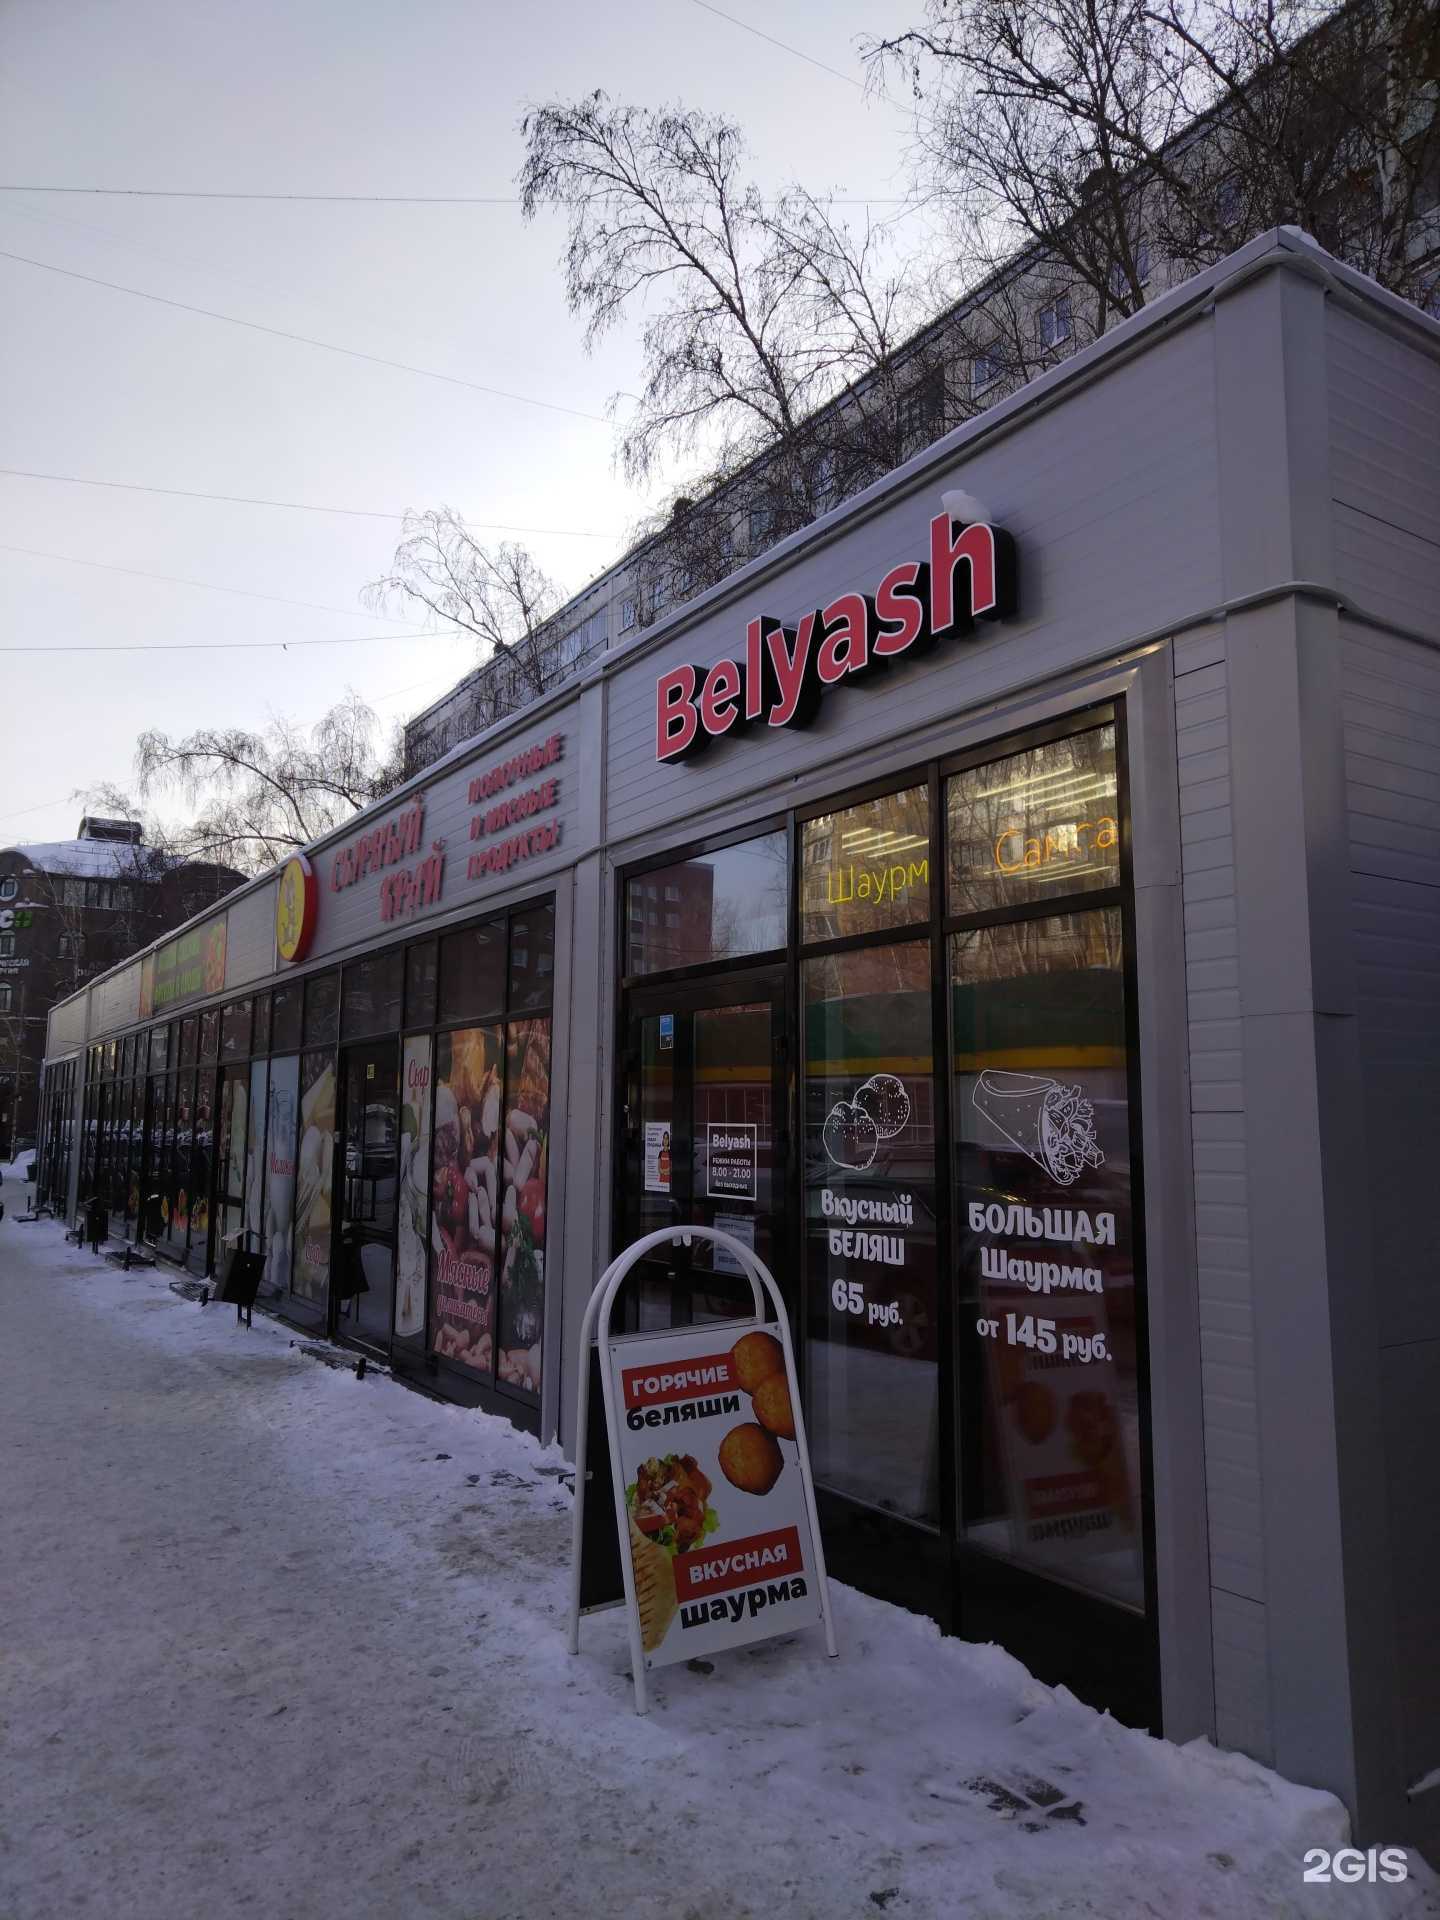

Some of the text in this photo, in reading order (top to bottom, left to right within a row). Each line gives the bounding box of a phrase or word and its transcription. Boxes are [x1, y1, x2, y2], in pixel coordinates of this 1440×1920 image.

[655, 512, 997, 762] Belyash
[826, 858, 929, 905] Шаурм
[712, 1133, 751, 1151] Belyash
[733, 1168, 751, 1178] 21.00
[820, 1188, 914, 1227] Вкусный
[967, 1201, 1117, 1246] БОЛЬШАЯ
[980, 1246, 1104, 1295] Шаурма
[831, 1277, 904, 1328] 65 руб.
[976, 1313, 999, 1338] от
[1004, 1313, 1057, 1354] 145
[1061, 1331, 1113, 1363] руб.
[631, 1363, 730, 1397] ГОРЯЧИЕ
[626, 1391, 741, 1432] беляши
[688, 1543, 789, 1584] ВКУСНАЯ
[680, 1575, 808, 1630] шаурма
